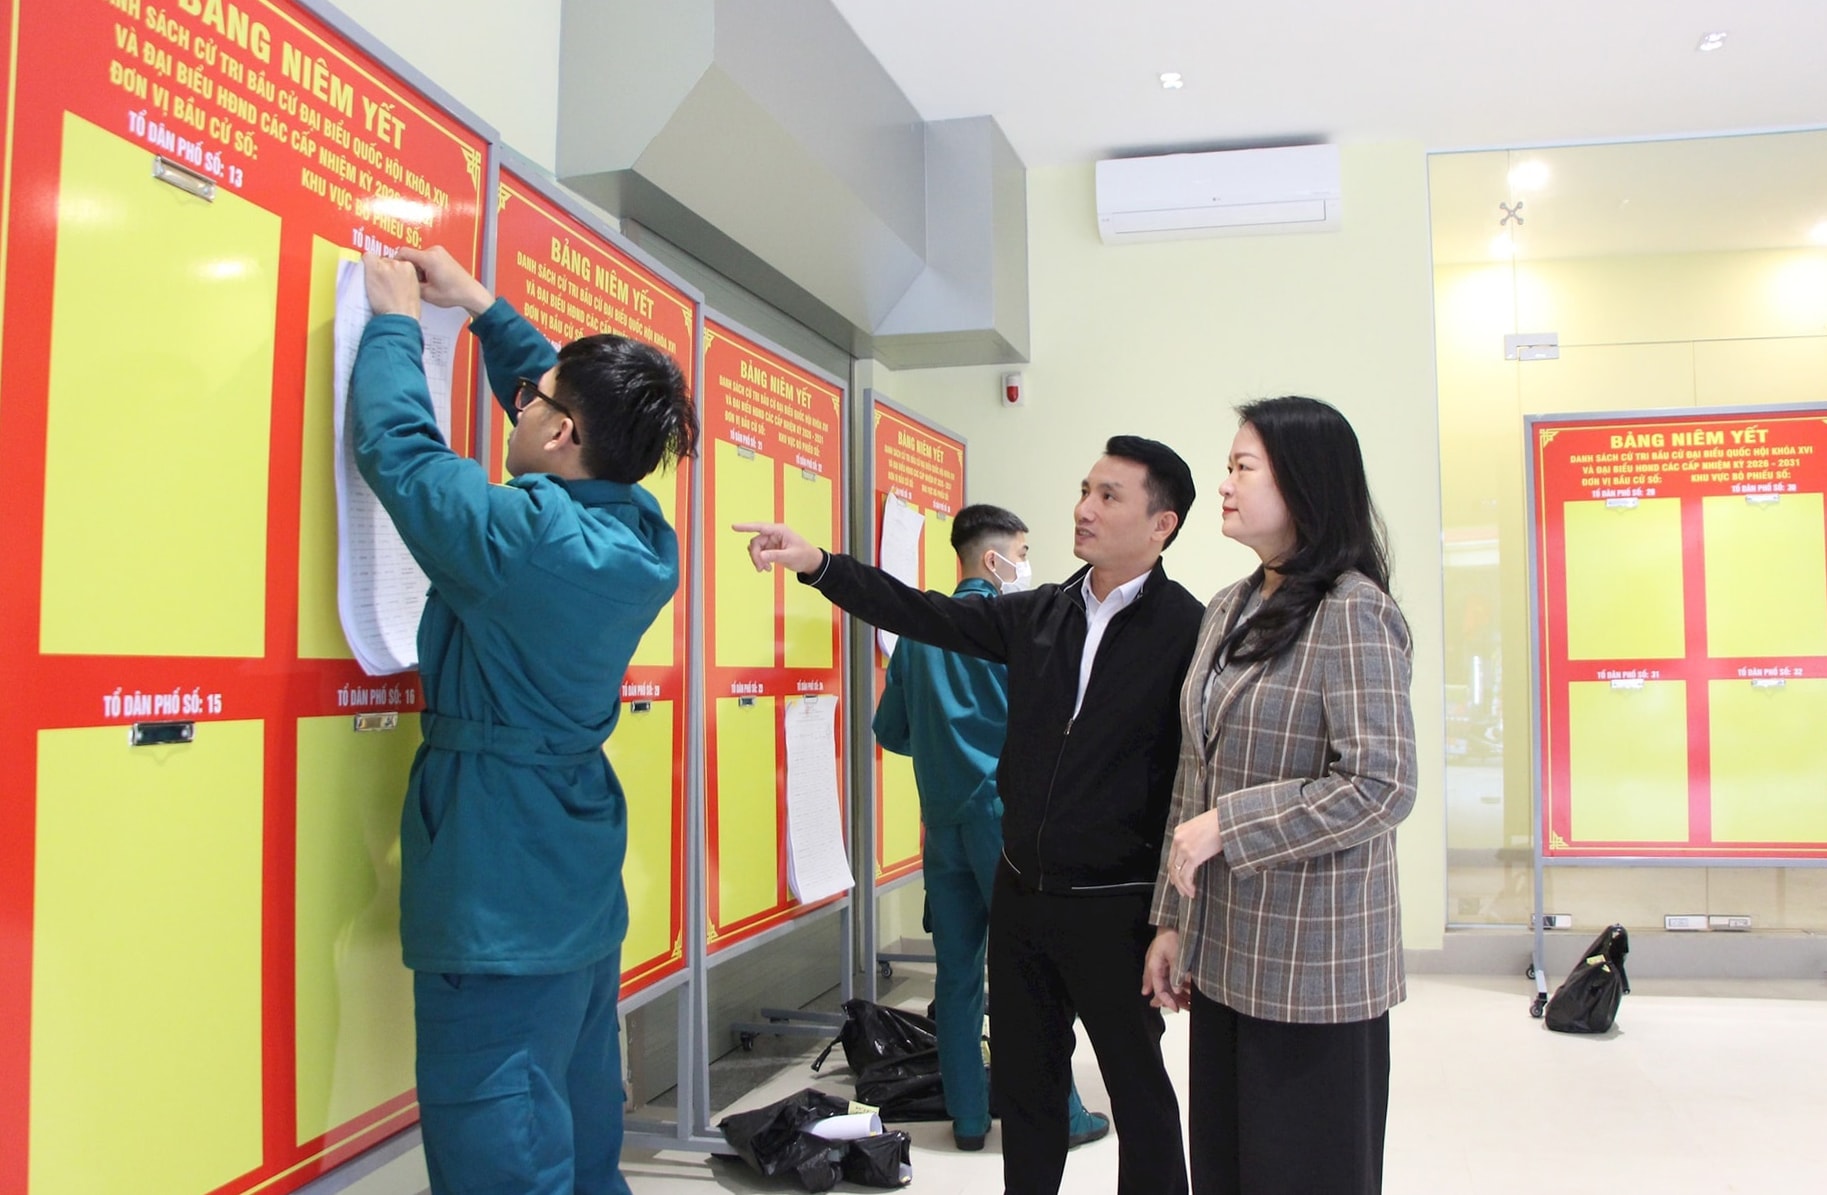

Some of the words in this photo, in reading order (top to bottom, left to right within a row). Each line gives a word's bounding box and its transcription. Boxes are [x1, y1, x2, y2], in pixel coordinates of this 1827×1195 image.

[109, 59, 148, 100] ĐƠN
[152, 83, 170, 117] VỊ
[173, 95, 206, 131] BẦU
[209, 117, 232, 145] CỬ
[234, 131, 258, 160] SỐ:
[115, 22, 139, 58] VÀ
[143, 40, 172, 77] ĐẠI
[176, 61, 213, 100] BIỂU
[216, 85, 258, 125] HĐND
[260, 111, 288, 143] CÁC
[291, 127, 317, 158] CẤP
[319, 146, 357, 183] NHIỆM
[359, 169, 374, 193] KỲ
[145, 5, 190, 51] SÁCH
[194, 37, 218, 66] CỬ
[219, 51, 244, 84] TRI
[247, 69, 275, 103] BẦU
[278, 90, 298, 116] CỬ
[300, 102, 321, 133] ĐẠI
[323, 118, 351, 149] BIỂU
[353, 137, 383, 169] QUỐC
[385, 156, 404, 183] HỘI
[405, 169, 431, 200] KHÓA
[433, 186, 449, 209] XVI
[281, 41, 354, 118] NIÊM
[361, 95, 406, 150] YẾT
[128, 109, 148, 137] TỔ
[147, 121, 175, 153] DÂN
[176, 136, 204, 167] PHỐ
[204, 151, 225, 178] SỐ:
[228, 165, 244, 188] 13
[302, 167, 327, 197] KHU
[329, 182, 353, 211] VỰC
[405, 226, 422, 250] SỐ:
[551, 236, 591, 282] BẢNG
[595, 264, 629, 306] NIÊM
[632, 287, 655, 320] YẾT
[741, 359, 768, 389] BẢNG
[770, 375, 793, 402] NIÊM
[796, 386, 812, 410] YẾT
[1610, 431, 1664, 449] BẢNG
[1671, 429, 1725, 447] NIÊM
[1730, 424, 1769, 444] YẾT
[103, 687, 122, 717] TỔ
[123, 693, 152, 716] DÂN
[154, 687, 180, 714] PHỐ
[182, 686, 203, 714] SỐ:
[206, 693, 222, 714] 15
[337, 682, 350, 707] TỔ
[350, 686, 369, 706] DÂN
[370, 682, 387, 705] PHỐ
[388, 682, 402, 705] SỐ:
[405, 688, 415, 705] 16
